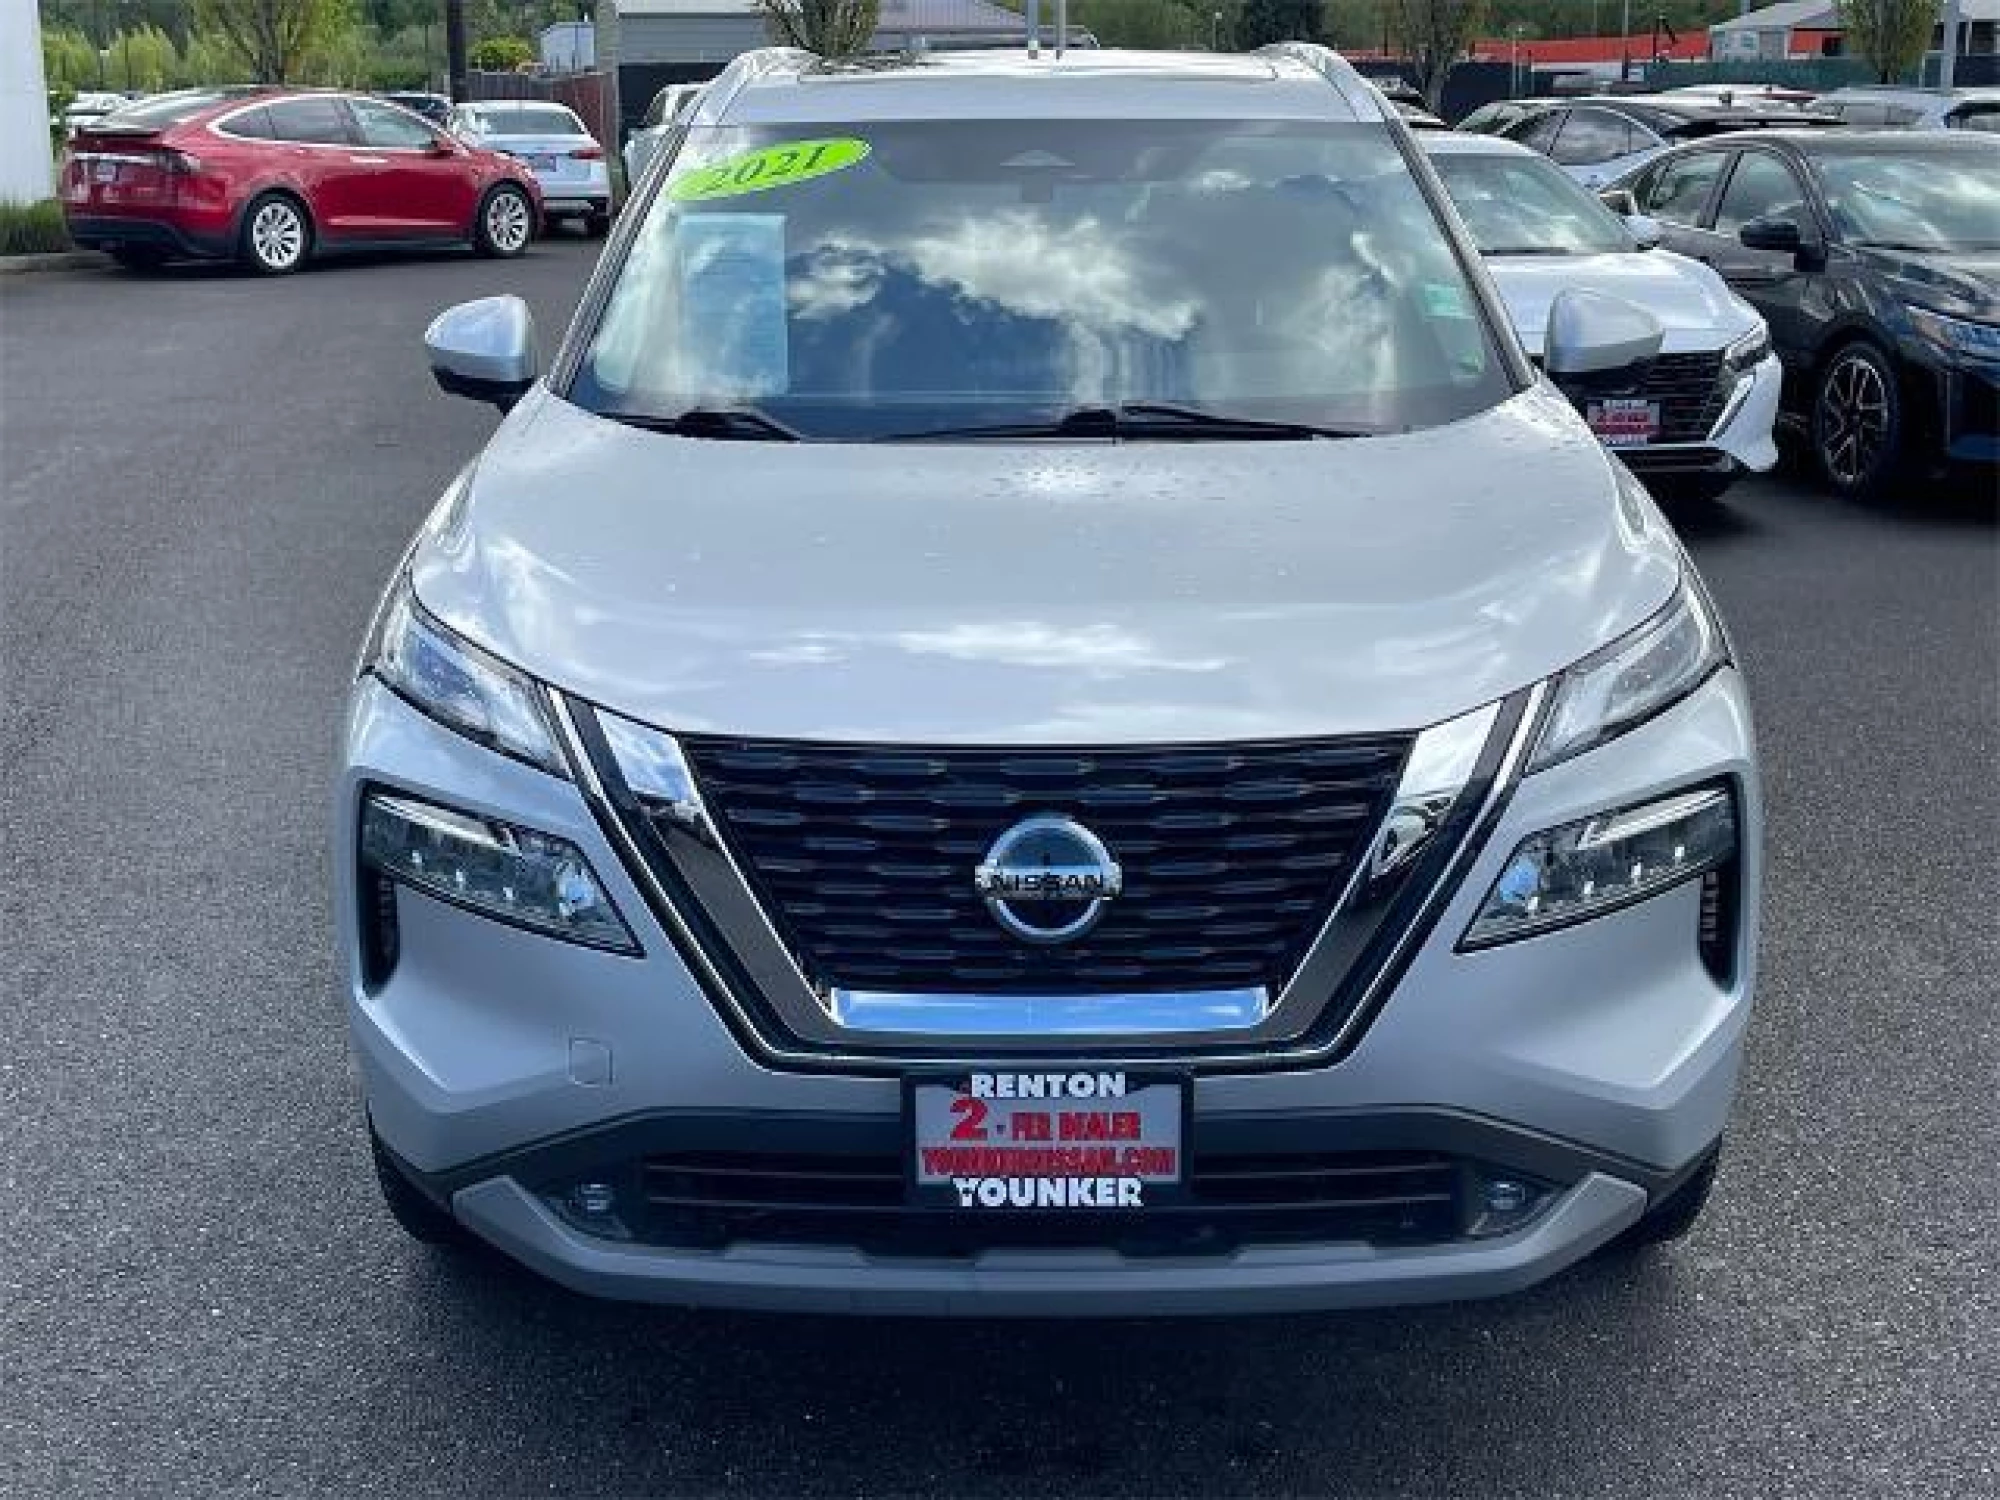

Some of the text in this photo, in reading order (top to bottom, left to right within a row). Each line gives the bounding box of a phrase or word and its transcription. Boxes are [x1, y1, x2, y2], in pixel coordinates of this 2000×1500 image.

[699, 146, 826, 193] 2021
[989, 874, 1104, 892] NISSAN
[971, 1072, 1126, 1098] RENTON
[950, 1099, 988, 1141] 2
[1059, 1112, 1141, 1141] DEALER
[952, 1178, 1145, 1207] YOUNKER
